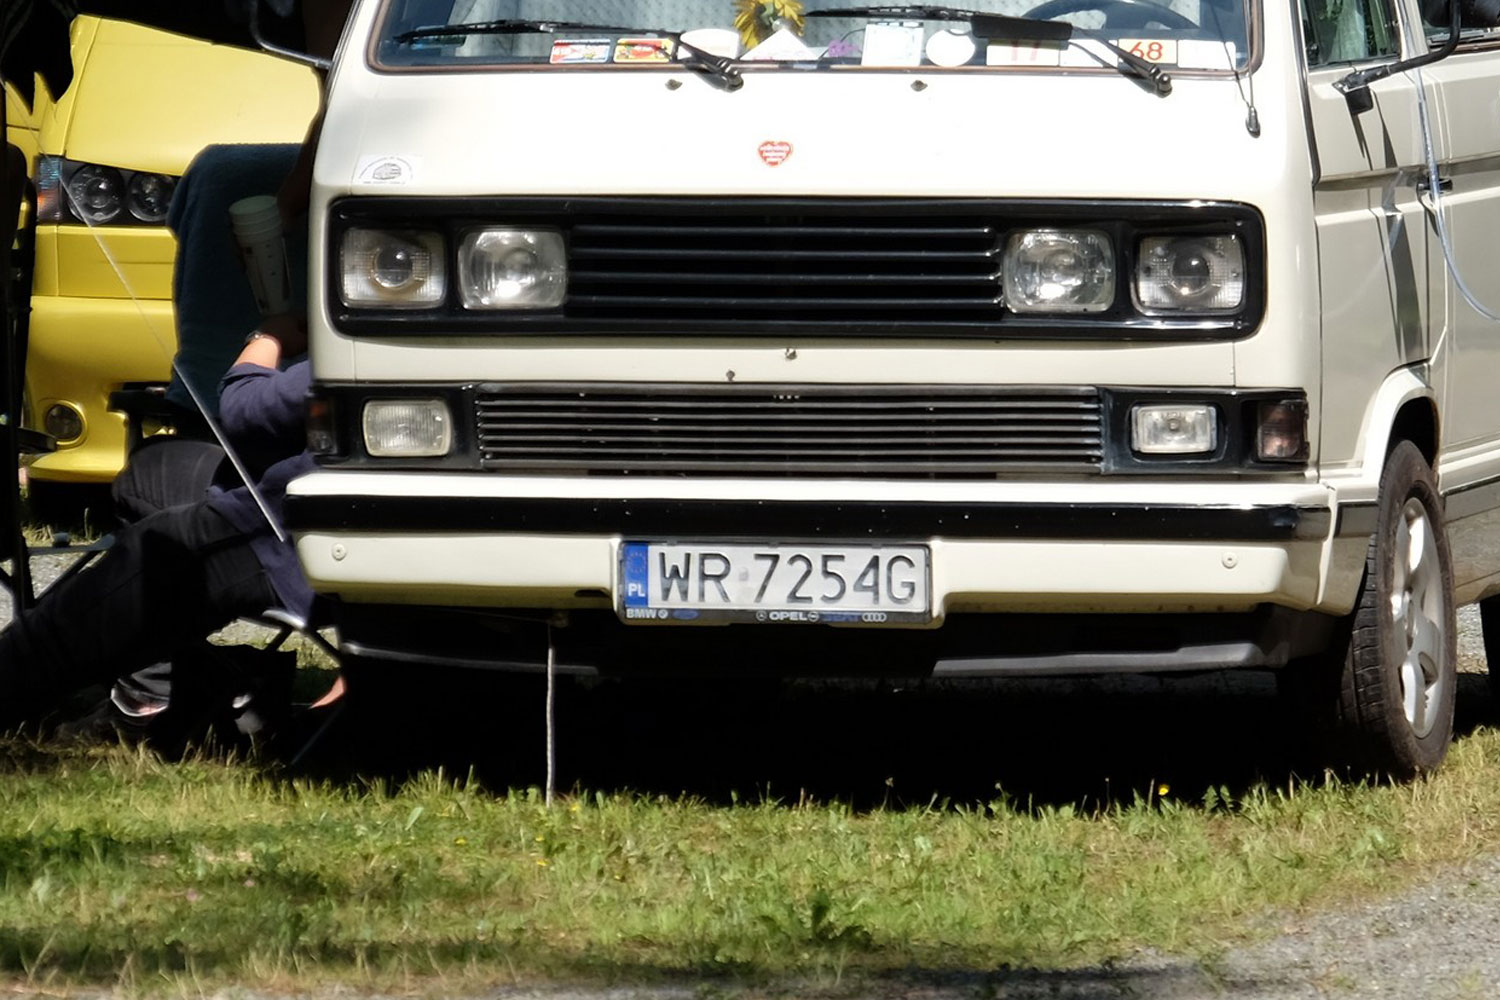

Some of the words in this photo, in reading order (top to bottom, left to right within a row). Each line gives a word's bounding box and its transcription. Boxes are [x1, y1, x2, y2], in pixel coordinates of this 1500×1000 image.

[1130, 41, 1163, 61] 68
[658, 552, 731, 603] WR
[754, 553, 917, 605] 7254G
[628, 584, 645, 598] PL
[626, 608, 657, 619] BMW
[769, 611, 808, 621] OPEL
